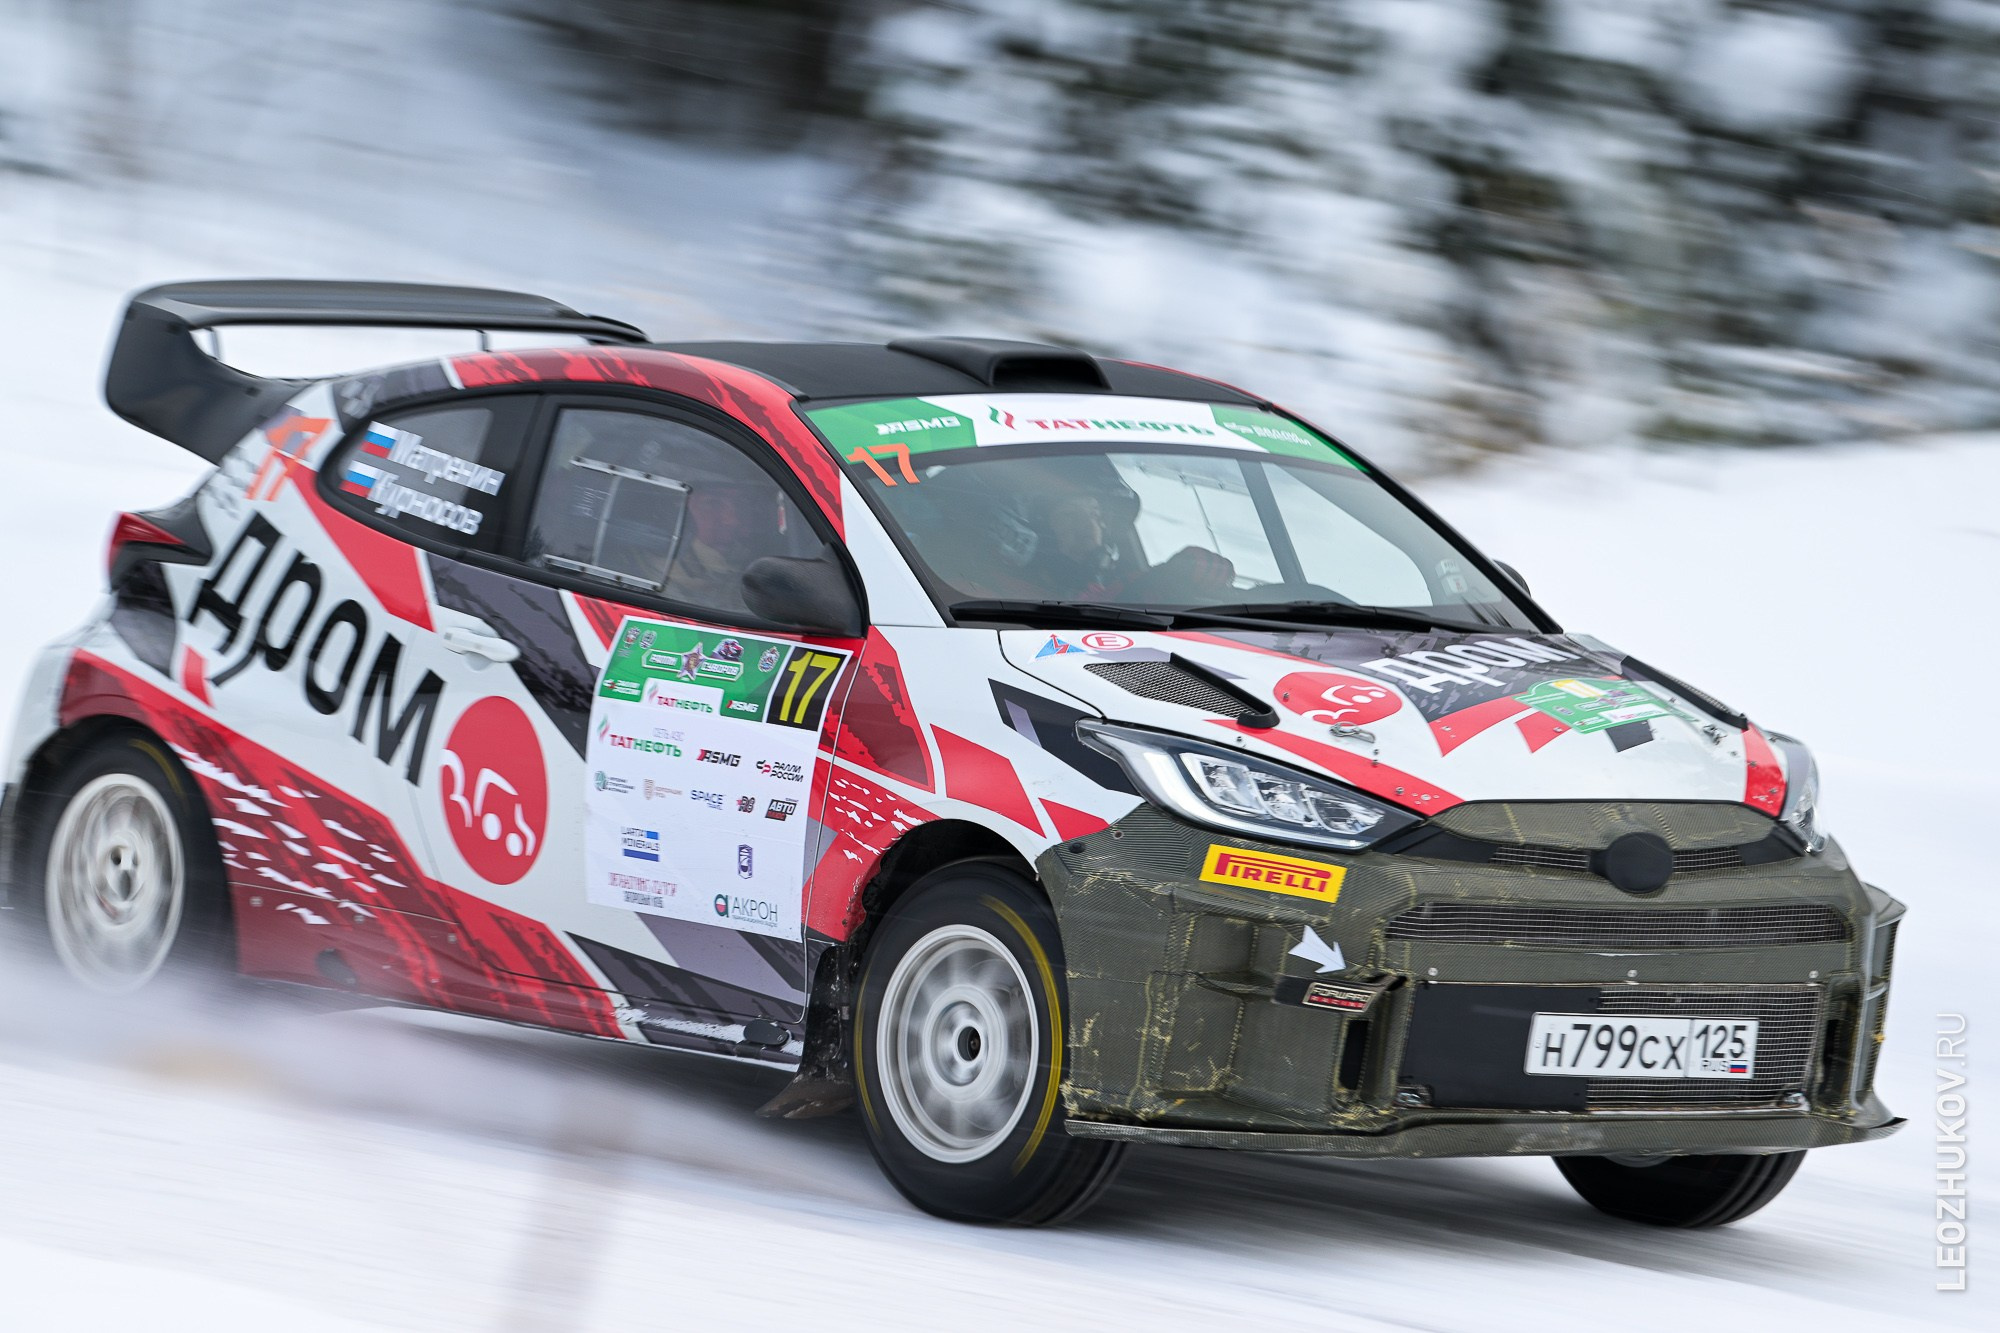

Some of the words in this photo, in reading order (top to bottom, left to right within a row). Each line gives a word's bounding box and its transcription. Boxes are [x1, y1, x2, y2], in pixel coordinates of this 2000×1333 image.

[1026, 418, 1215, 436] ТАТНЕФТЬ
[846, 443, 920, 487] 17
[779, 651, 841, 725] 17
[656, 695, 713, 714] ТАТНЕФТЬ
[610, 734, 682, 758] ТАТНЕФТЬ
[770, 769, 804, 783] РОССИИ
[691, 789, 723, 805] SPACE
[768, 801, 795, 815] АВТО
[1214, 853, 1332, 893] PIRELLI
[732, 896, 778, 922] АКРОН
[1696, 1025, 1748, 1059] 125
[1700, 1059, 1729, 1072] RUS
